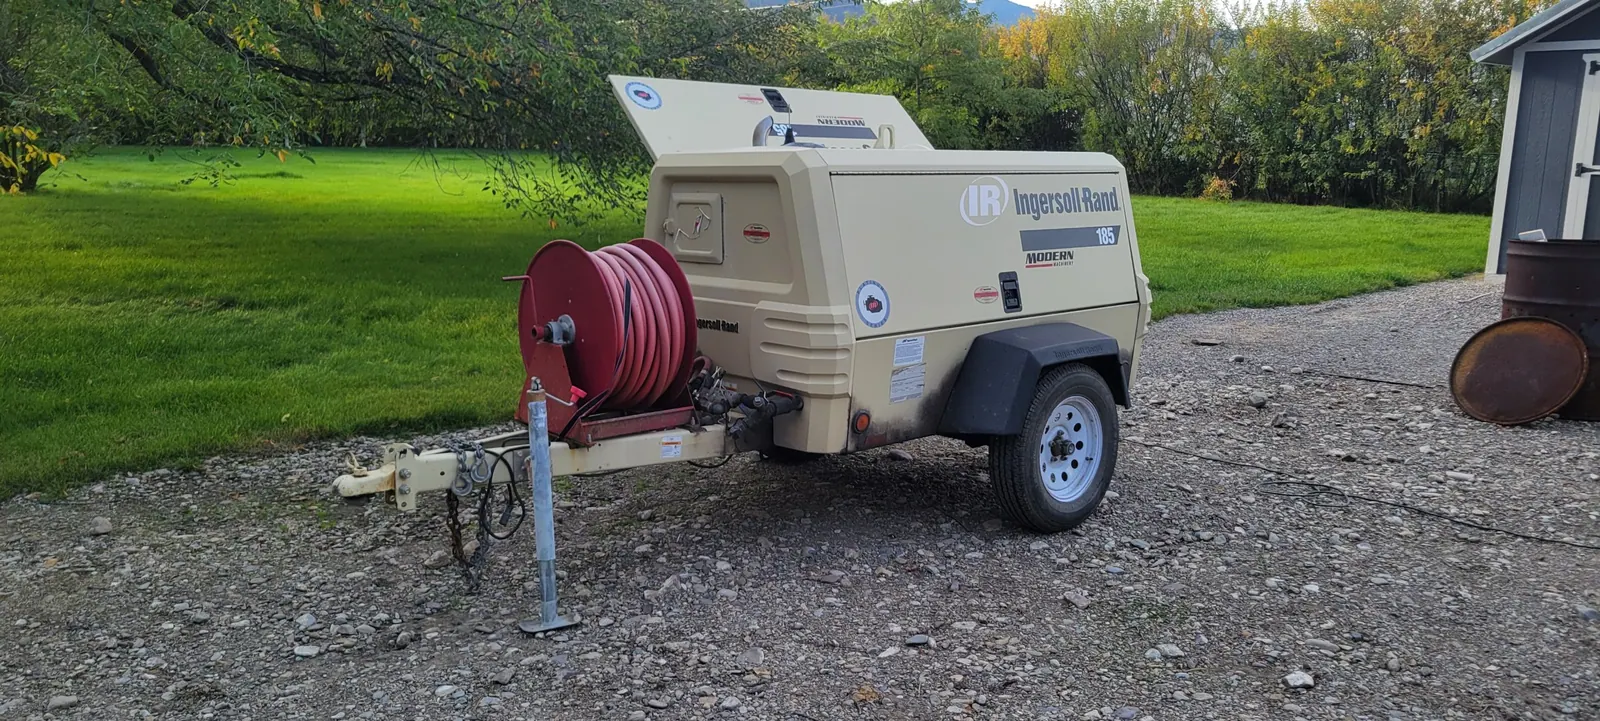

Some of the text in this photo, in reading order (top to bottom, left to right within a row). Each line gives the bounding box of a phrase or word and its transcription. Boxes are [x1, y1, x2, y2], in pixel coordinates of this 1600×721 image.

[968, 185, 1000, 216] IR
[1096, 227, 1115, 244] 185
[1026, 251, 1074, 264] MODERN
